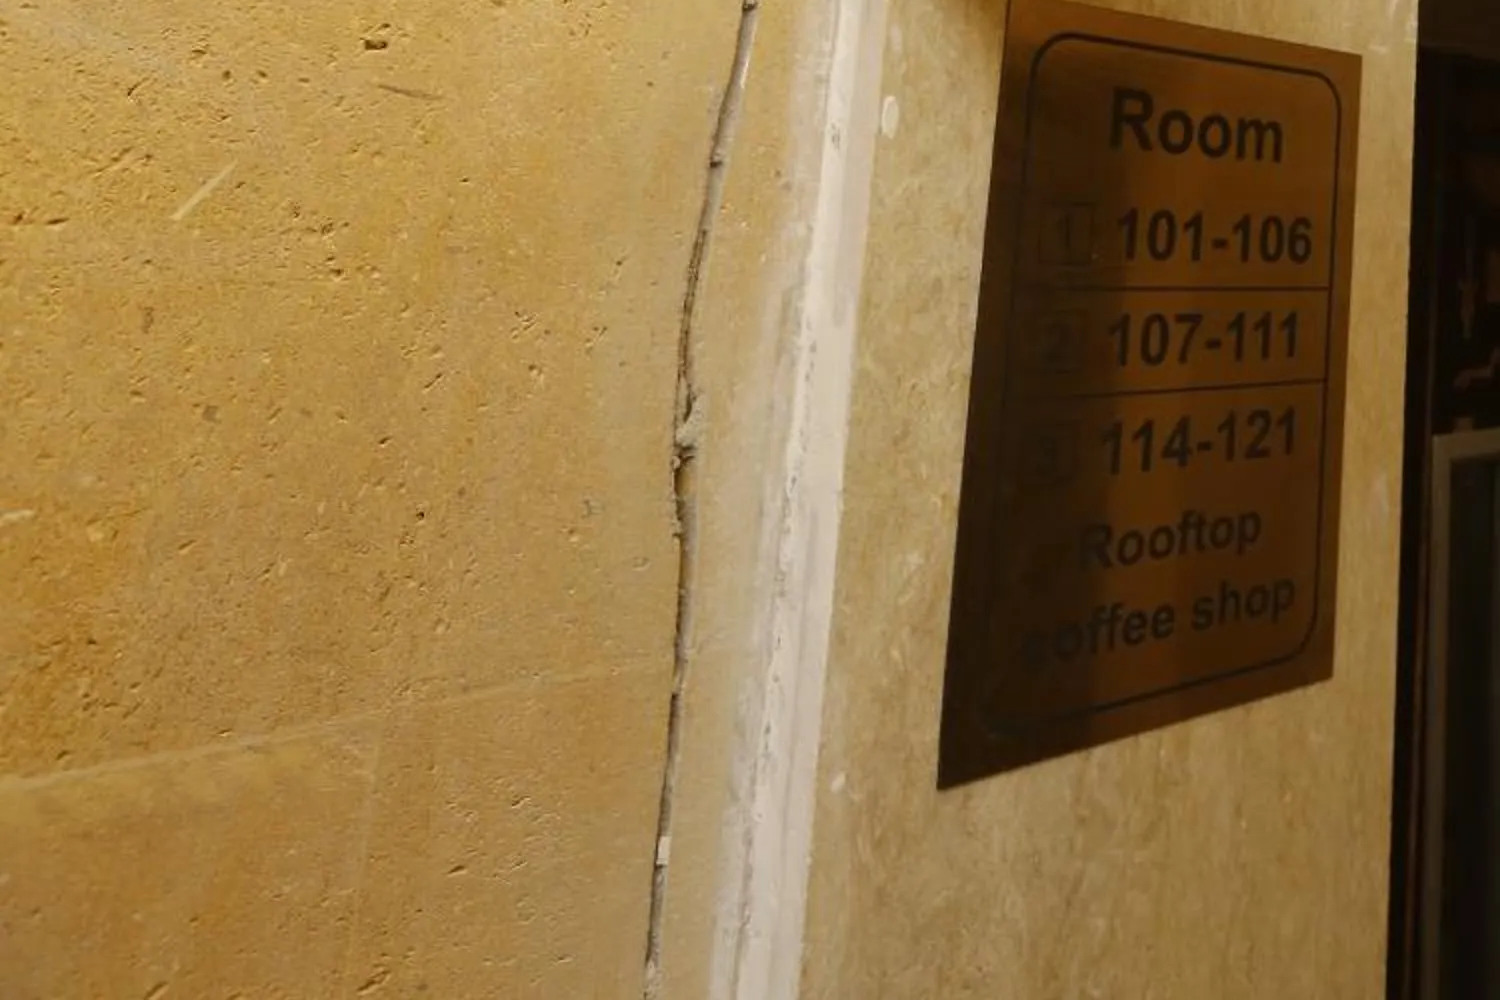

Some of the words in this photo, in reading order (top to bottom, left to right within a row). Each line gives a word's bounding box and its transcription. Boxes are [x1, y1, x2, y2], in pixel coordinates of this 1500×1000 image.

[1110, 87, 1283, 162] Room
[1117, 207, 1312, 265] 101-106
[1108, 312, 1299, 367] 107-111
[1102, 407, 1296, 477] 114-121
[1079, 507, 1261, 570] Rooftop
[1192, 576, 1295, 633] shop
